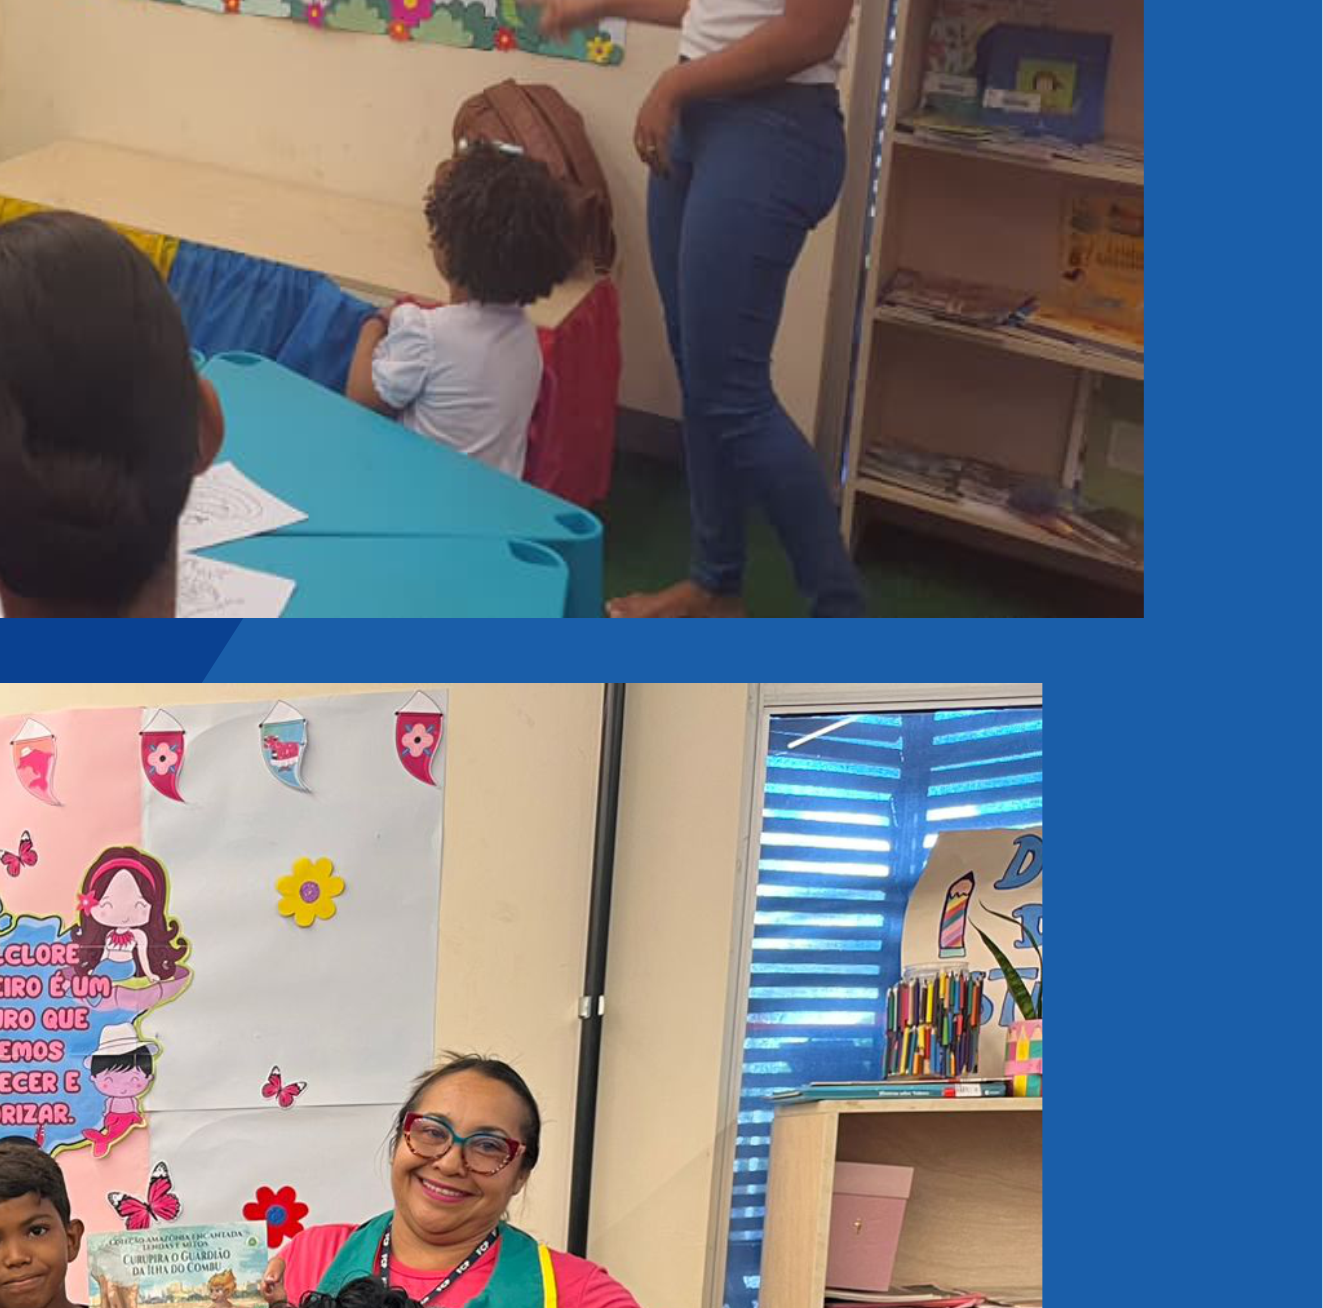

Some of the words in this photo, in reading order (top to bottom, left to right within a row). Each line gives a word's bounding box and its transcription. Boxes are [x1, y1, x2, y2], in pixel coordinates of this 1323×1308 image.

[48, 972, 65, 999] É
[70, 975, 112, 999] UM
[42, 1007, 90, 1031] QUE
[64, 1071, 81, 1093] E
[122, 1253, 169, 1265] CURUPIRA
[171, 1252, 179, 1262] O
[180, 1247, 231, 1262] GUARDIÃO
[132, 1266, 146, 1277] DA
[147, 1263, 169, 1275] ILHA
[171, 1263, 185, 1274] DO
[186, 1261, 222, 1273] COMBU
